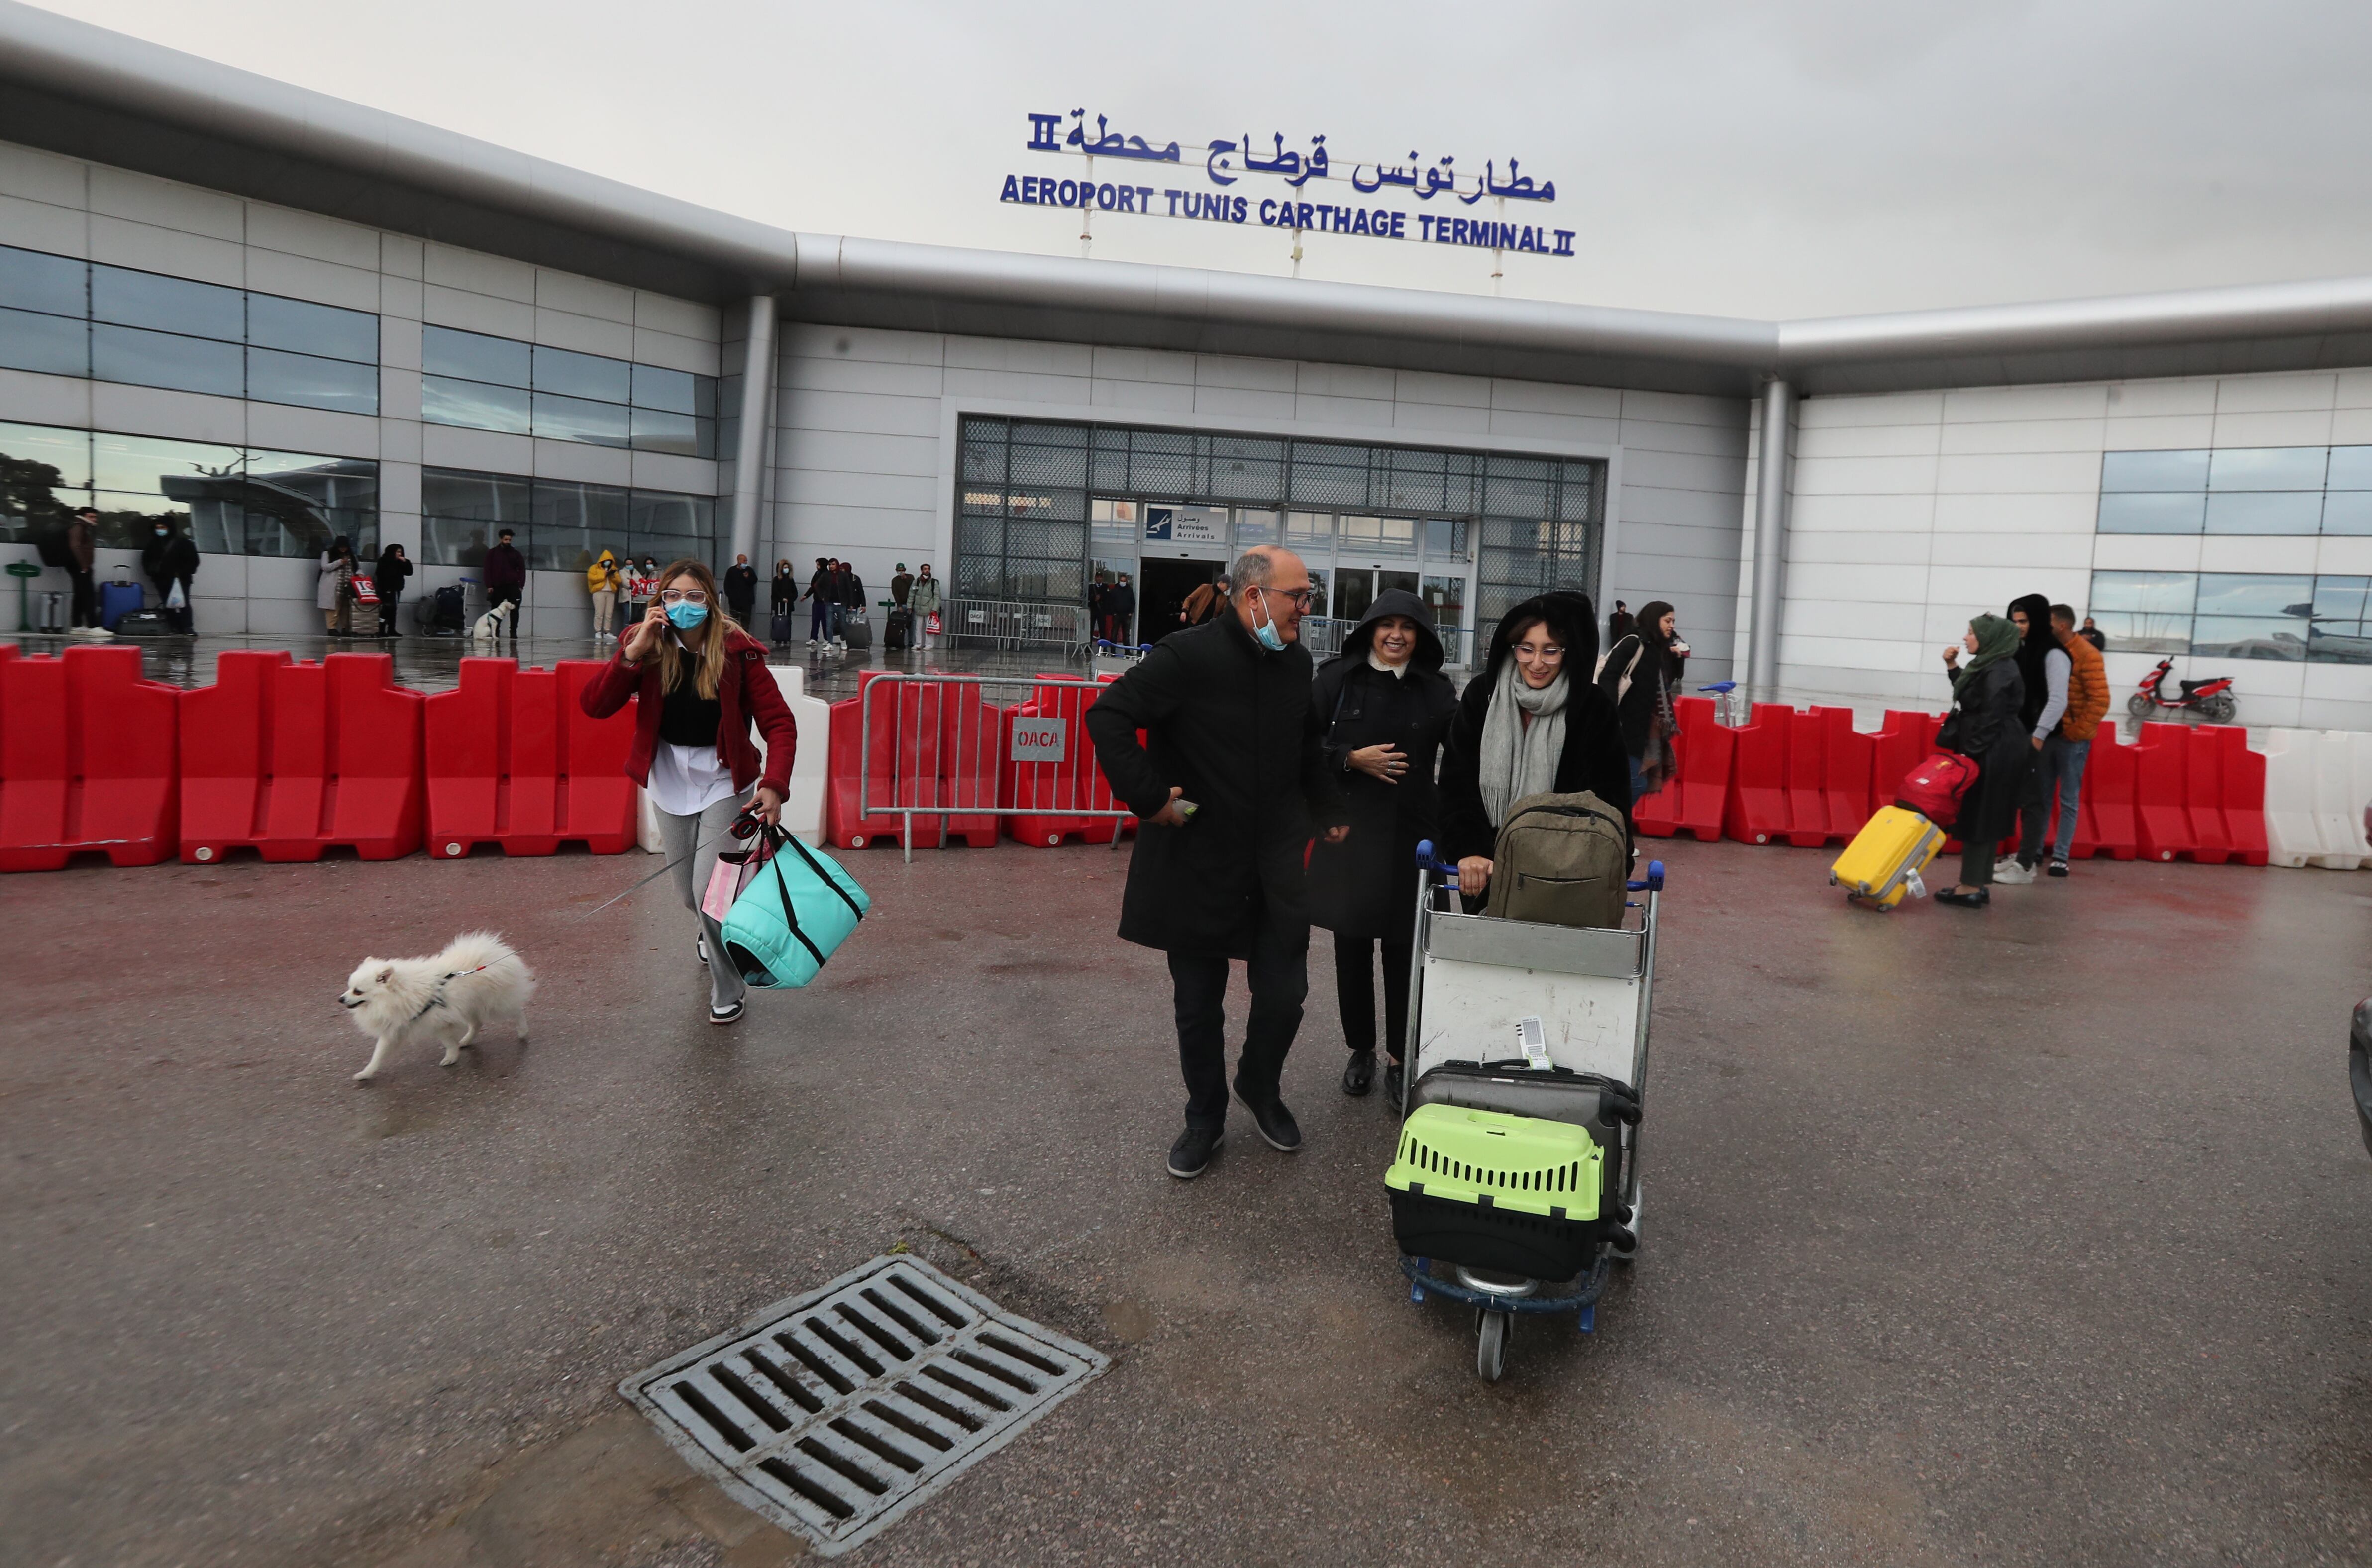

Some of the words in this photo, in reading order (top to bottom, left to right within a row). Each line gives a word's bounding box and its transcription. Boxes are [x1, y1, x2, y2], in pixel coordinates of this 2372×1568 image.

[1066, 107, 1181, 162] محطة
[1207, 132, 1329, 187] قرطاج
[1352, 150, 1455, 200] تونس
[1458, 156, 1556, 205] مطار
[1001, 174, 1155, 213] AEROPORT
[1165, 190, 1248, 224] TUNIS
[1259, 199, 1407, 238] CARTHAGE
[1418, 214, 1549, 253] TERMINAL
[1177, 514, 1200, 523] وصول
[1018, 731, 1060, 747] OACA
